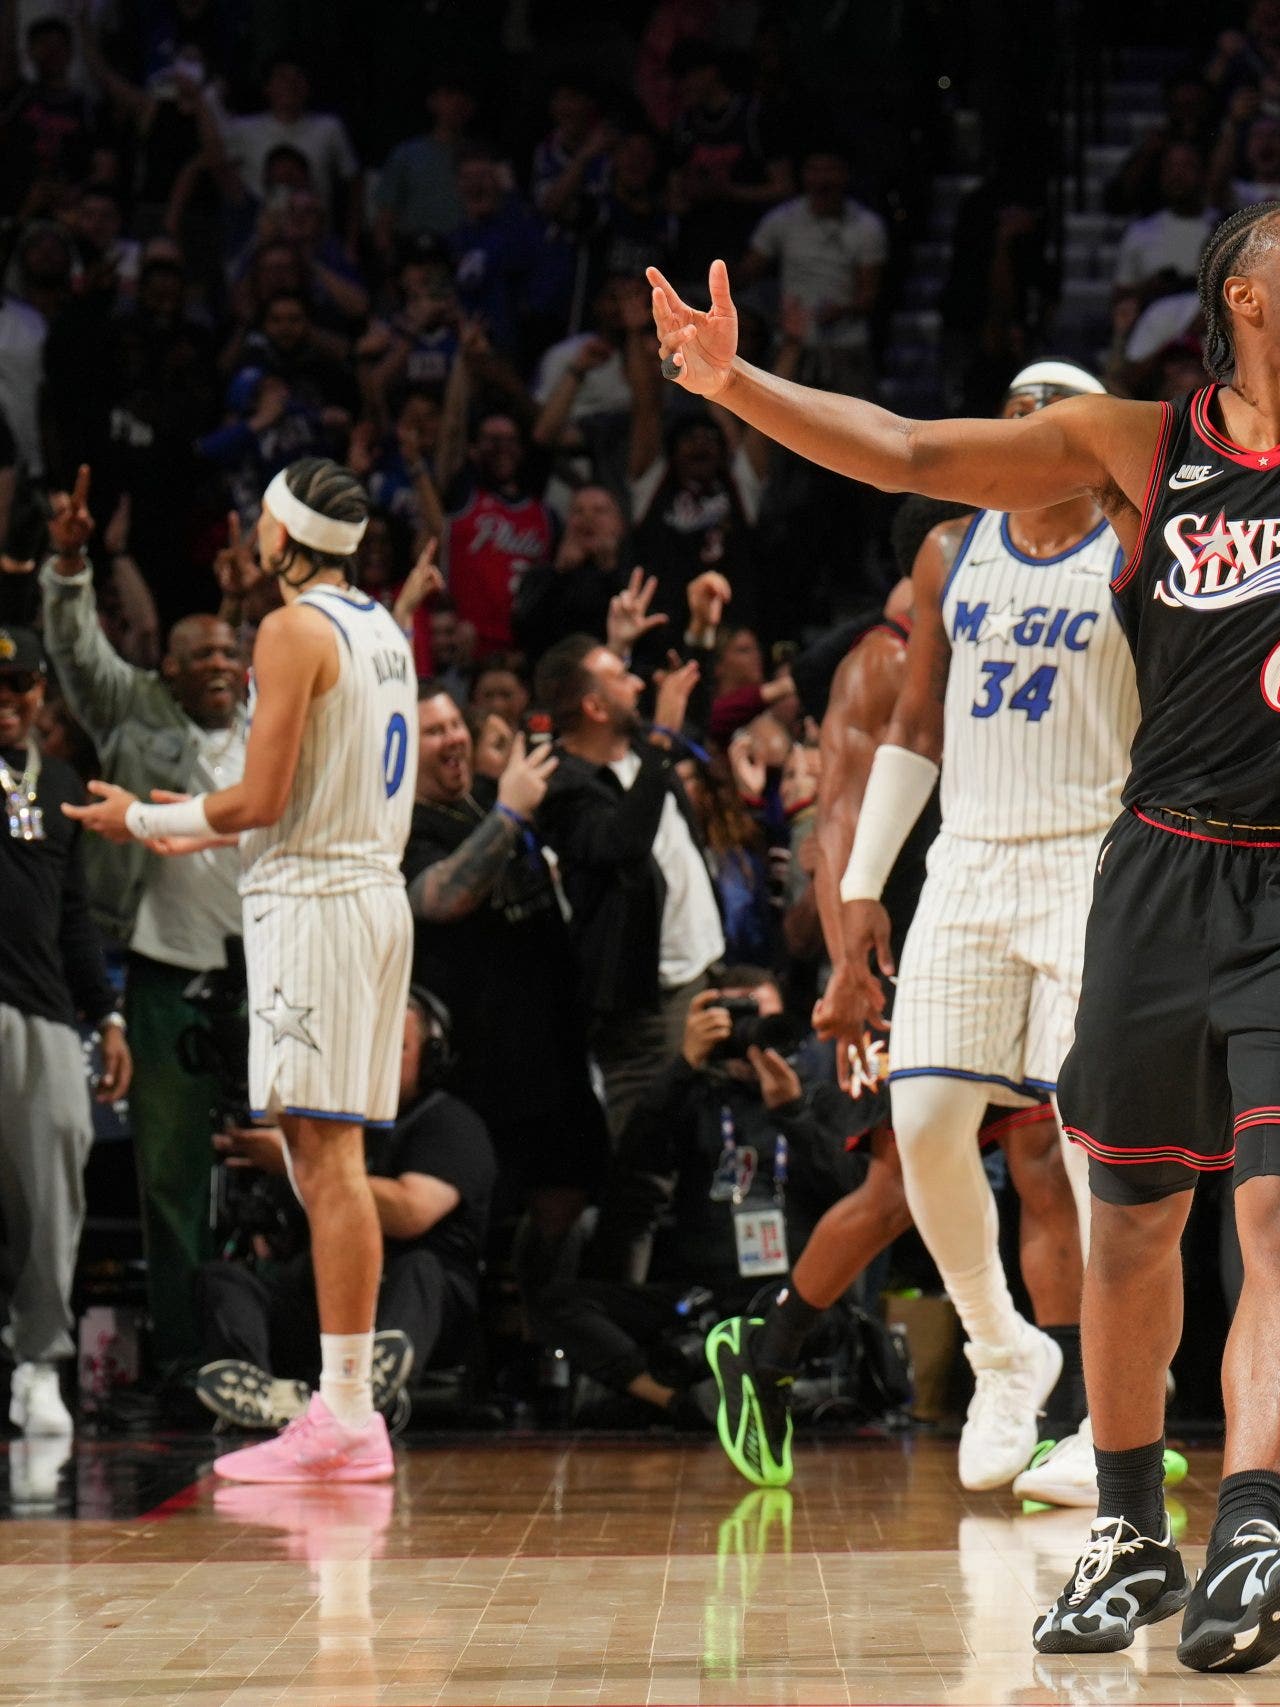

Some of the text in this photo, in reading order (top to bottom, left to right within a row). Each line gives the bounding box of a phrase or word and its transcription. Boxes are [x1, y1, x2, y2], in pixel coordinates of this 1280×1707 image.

[1176, 464, 1212, 480] NIKE
[971, 660, 1059, 722] 34
[384, 711, 408, 799] 0
